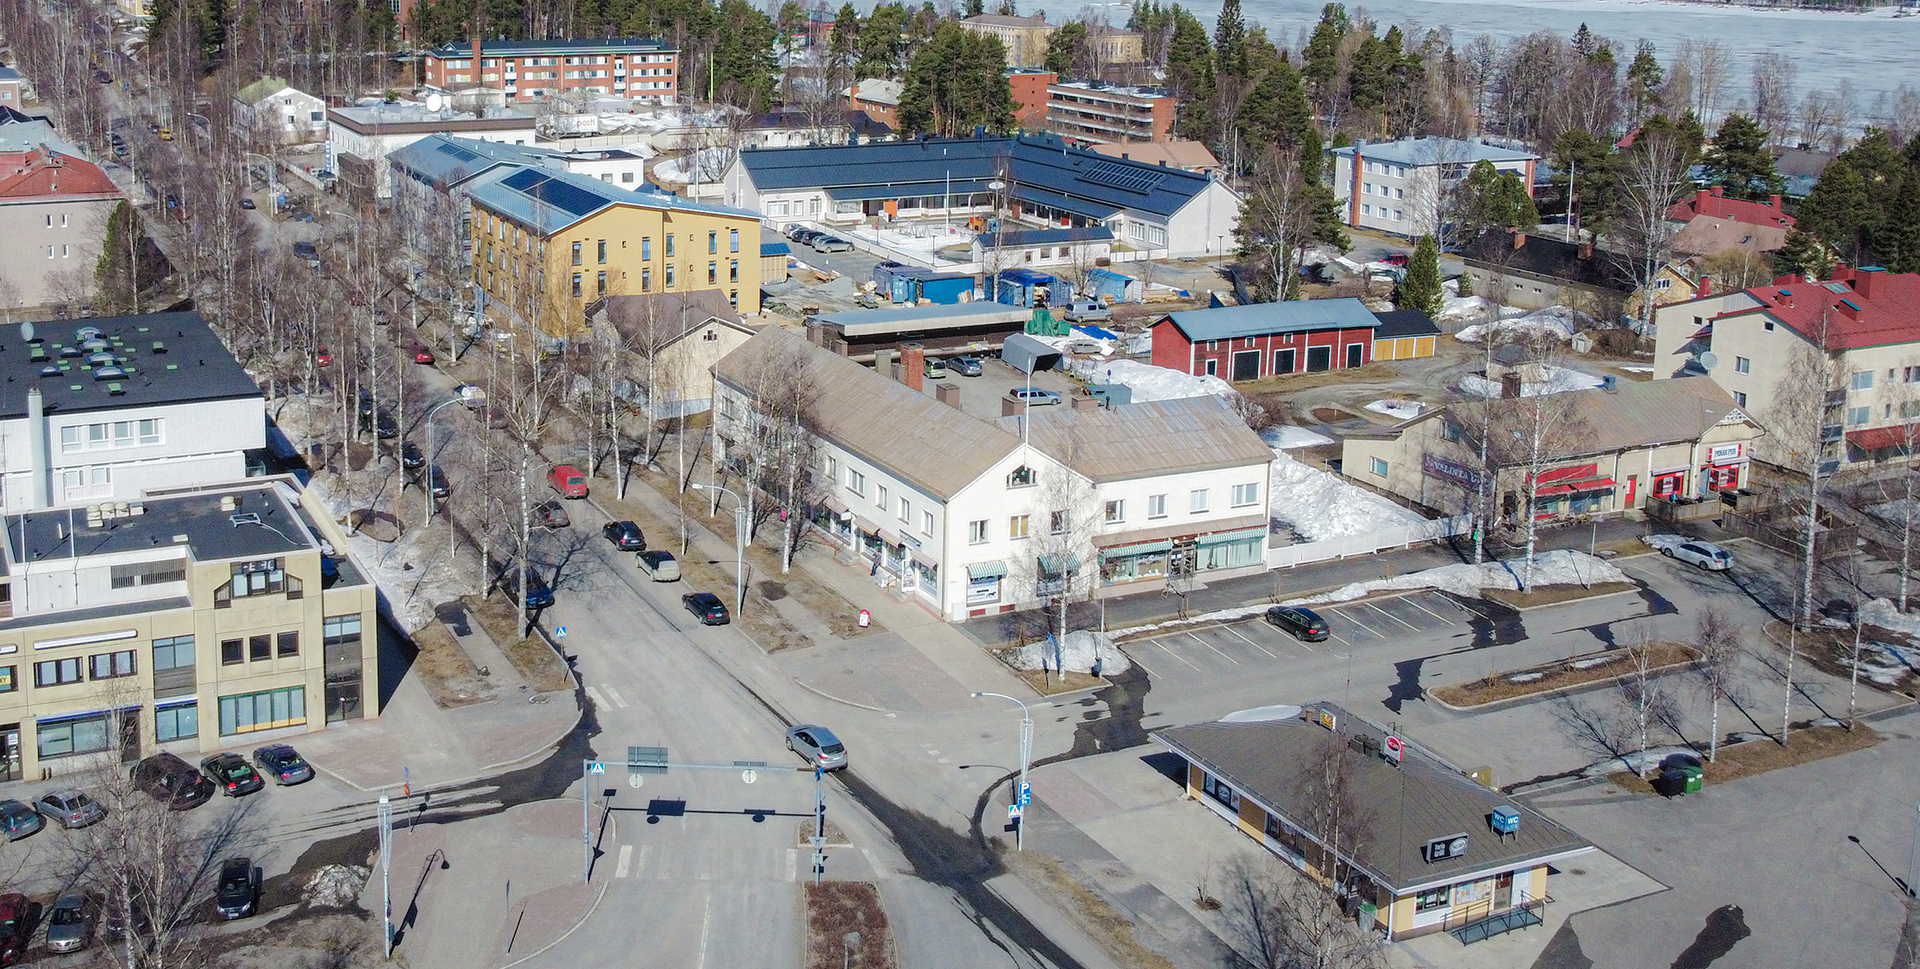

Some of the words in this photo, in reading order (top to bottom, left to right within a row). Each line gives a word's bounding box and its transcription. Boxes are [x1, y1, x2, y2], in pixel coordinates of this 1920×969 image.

[577, 119, 596, 128] posti
[1021, 783, 1029, 794] P
[1494, 811, 1505, 824] WC
[1507, 816, 1519, 825] WC
